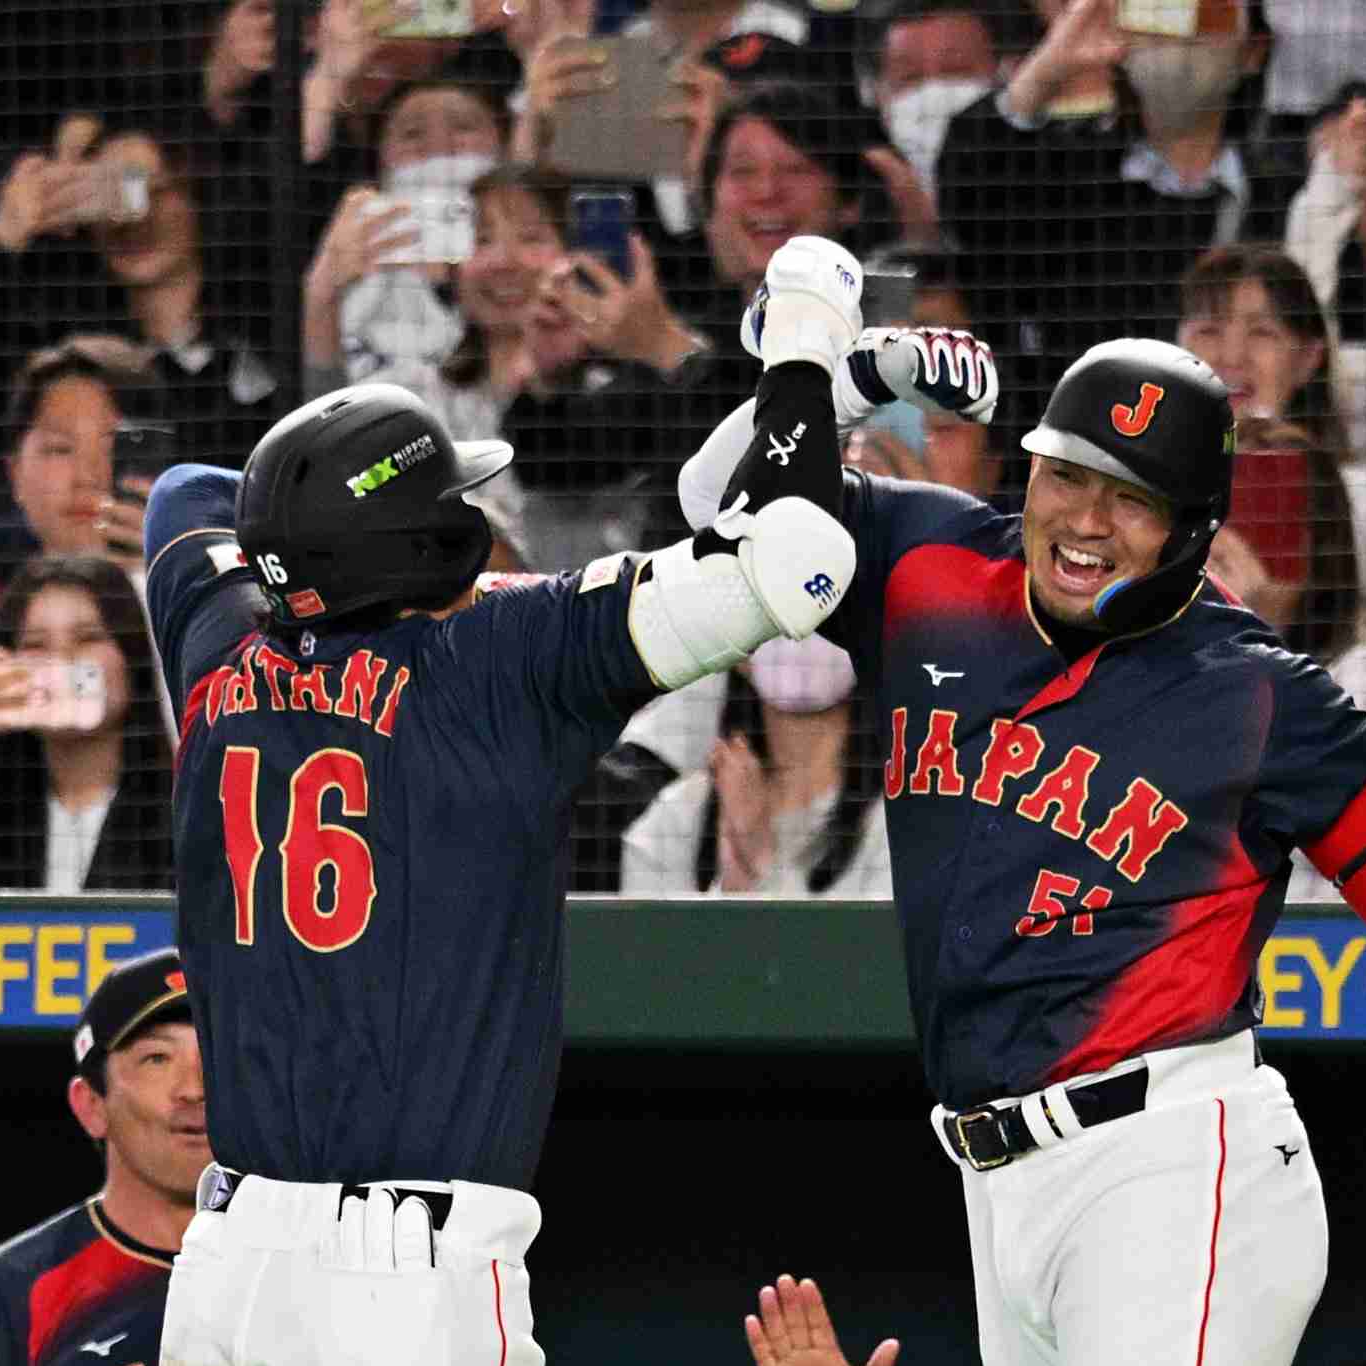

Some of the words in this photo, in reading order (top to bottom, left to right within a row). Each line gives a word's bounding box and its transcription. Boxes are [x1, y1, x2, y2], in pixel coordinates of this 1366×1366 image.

[1111, 382, 1164, 436] J
[256, 553, 288, 585] 16
[884, 707, 1188, 882] JAPAN
[219, 745, 377, 953] 16
[1015, 869, 1113, 938] 51
